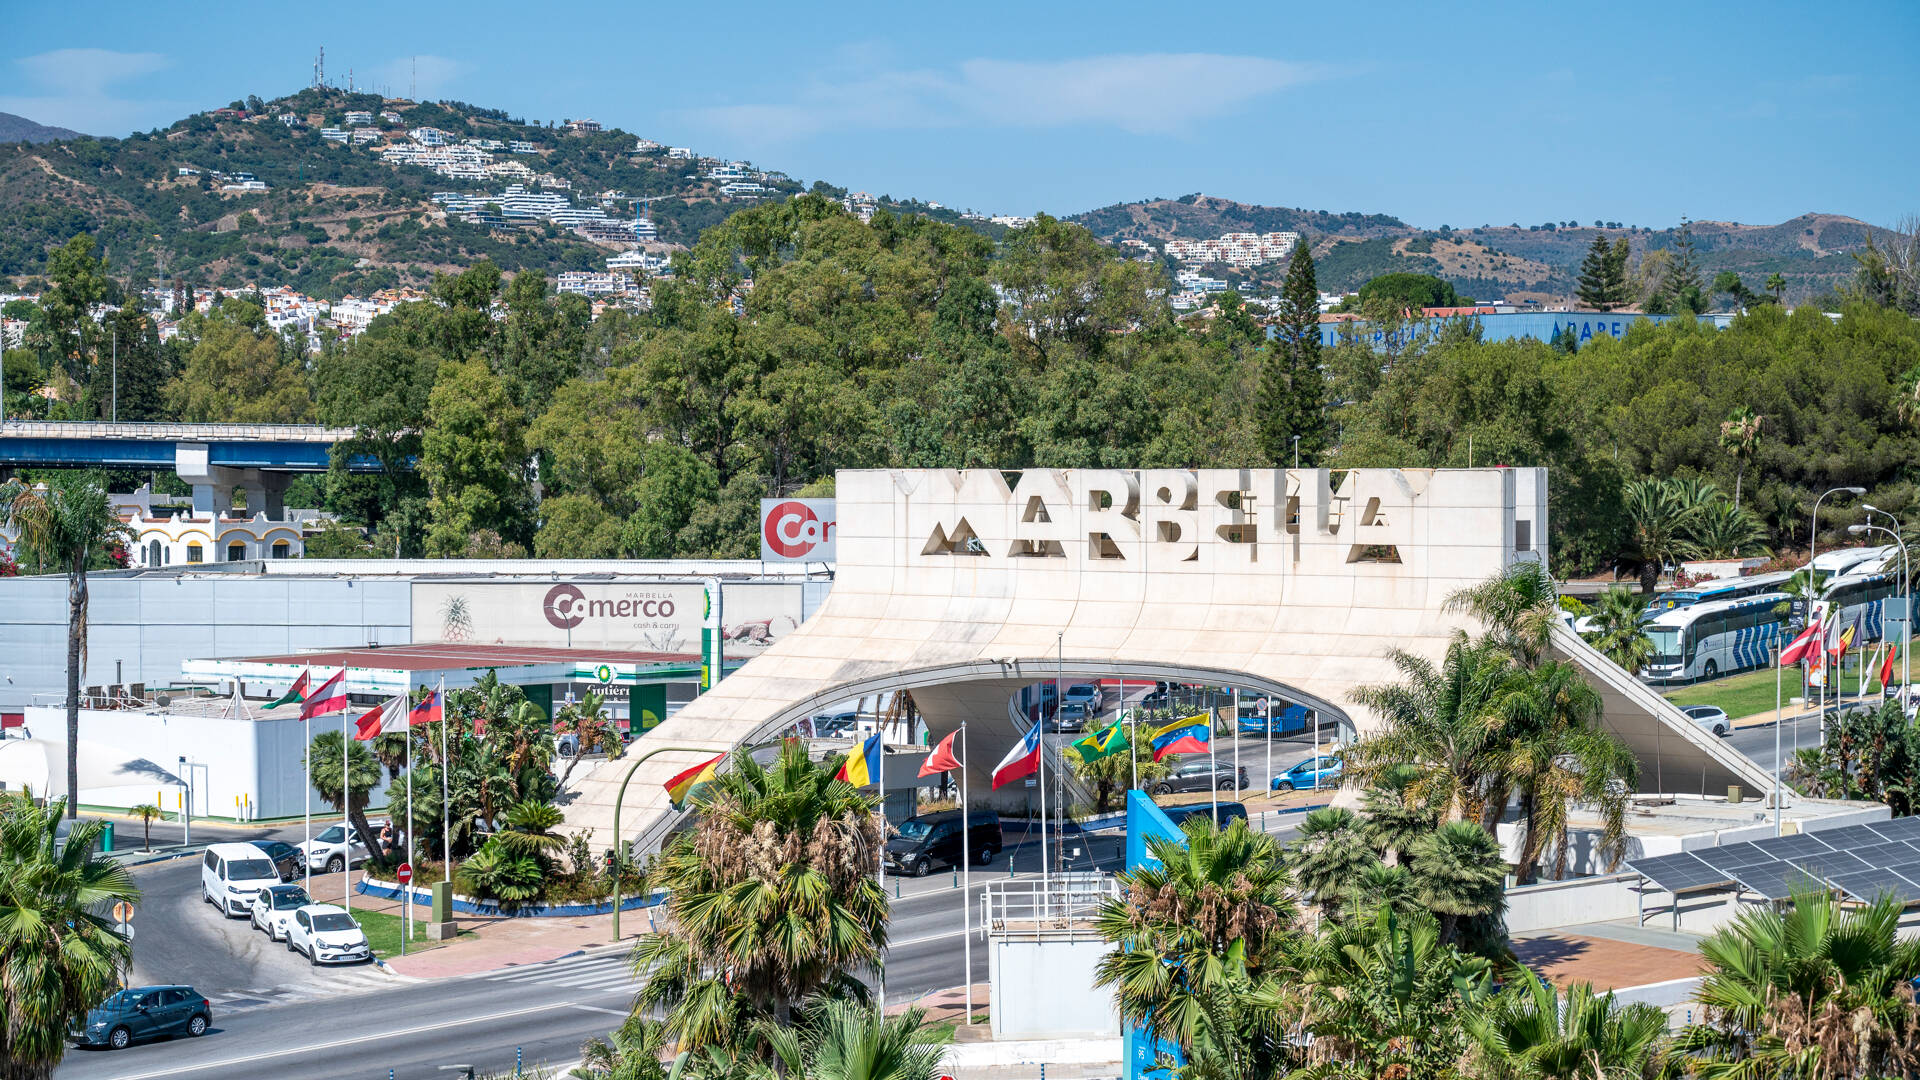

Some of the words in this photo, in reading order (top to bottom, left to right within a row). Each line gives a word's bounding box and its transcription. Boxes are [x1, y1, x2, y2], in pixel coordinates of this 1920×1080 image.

[906, 468, 1416, 565] MARBELLA
[547, 589, 675, 623] Comerco
[659, 622, 680, 630] carry
